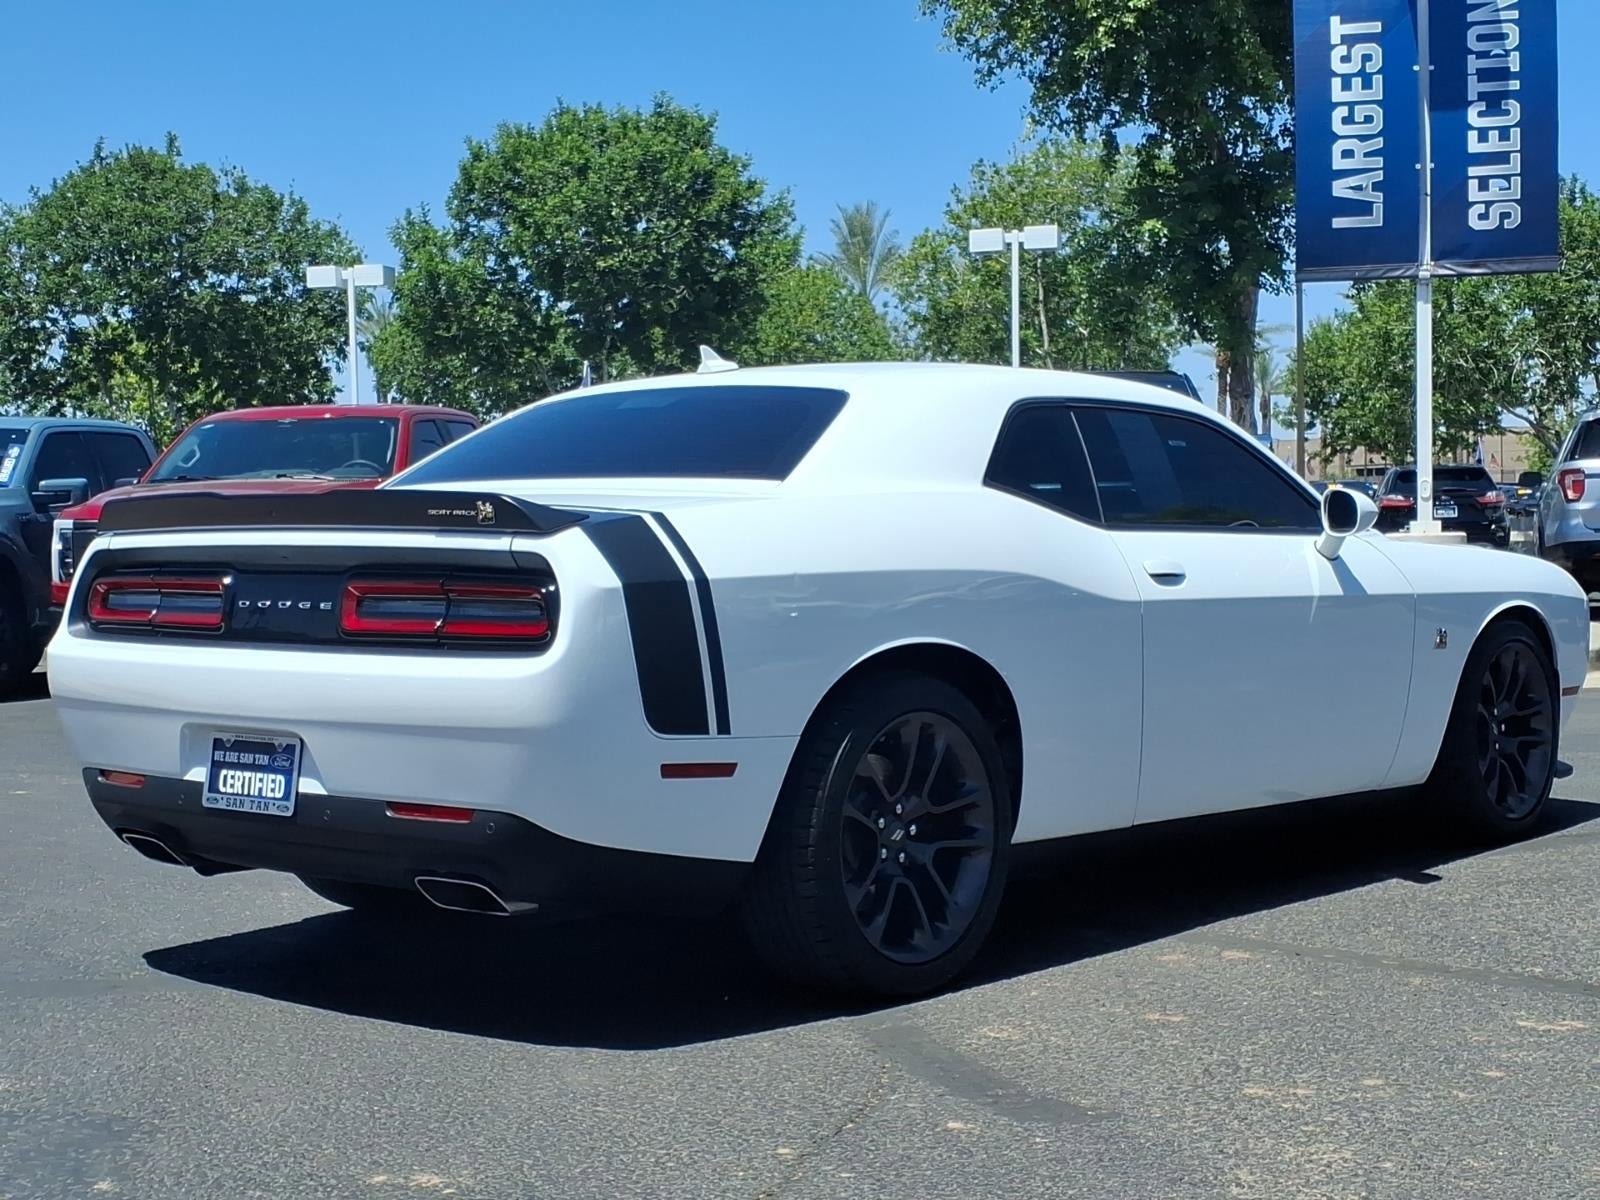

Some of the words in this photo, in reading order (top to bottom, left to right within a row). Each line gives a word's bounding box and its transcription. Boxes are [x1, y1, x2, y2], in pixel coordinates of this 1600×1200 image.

[1330, 15, 1383, 229] LARGEST
[1466, 0, 1522, 231] SELECTION
[238, 600, 332, 610] DODGE
[214, 750, 224, 761] WE
[225, 751, 239, 763] ARE
[240, 753, 254, 764] SAN
[255, 754, 270, 765] TAN
[219, 769, 285, 798] CERTIFIED
[225, 797, 245, 808] SAN
[249, 799, 270, 812] TAN
